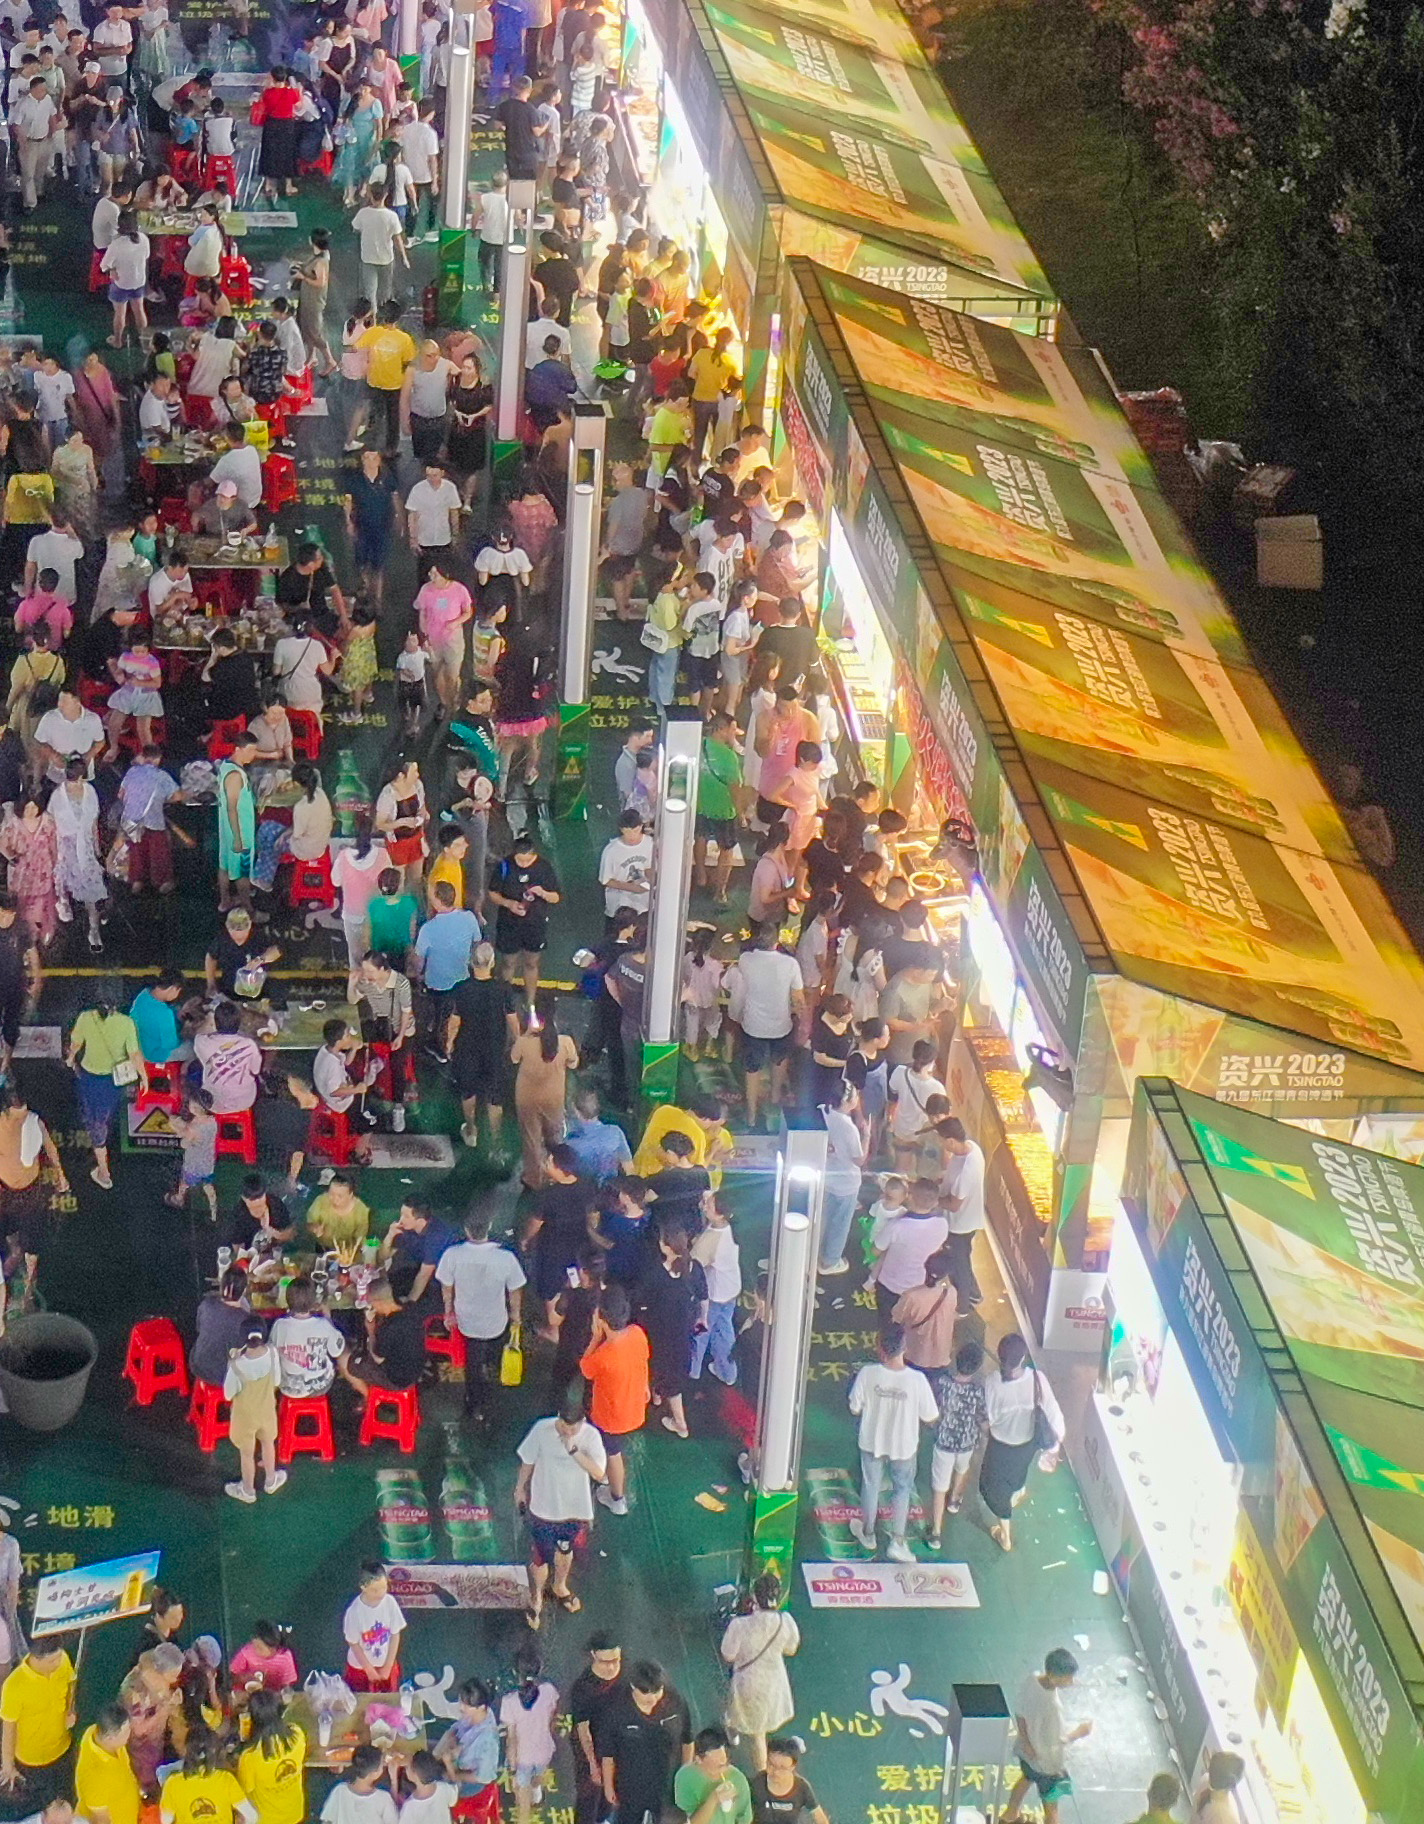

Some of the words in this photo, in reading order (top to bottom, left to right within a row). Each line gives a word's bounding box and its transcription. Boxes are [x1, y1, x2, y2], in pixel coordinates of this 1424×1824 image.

[906, 266, 948, 282] 2023
[1220, 1054, 1283, 1087] 资兴
[1287, 1054, 1345, 1075] 2023
[1287, 1075, 1344, 1087] TSINGTAO
[1311, 1142, 1371, 1209] 2023
[1338, 1203, 1424, 1288] 资兴
[47, 1504, 116, 1528] 地滑
[816, 1581, 878, 1592] TSINGTAO
[894, 1573, 967, 1598] 120
[1313, 1563, 1358, 1675] 资兴
[1353, 1643, 1390, 1736] 2023
[810, 1711, 883, 1737] 小心
